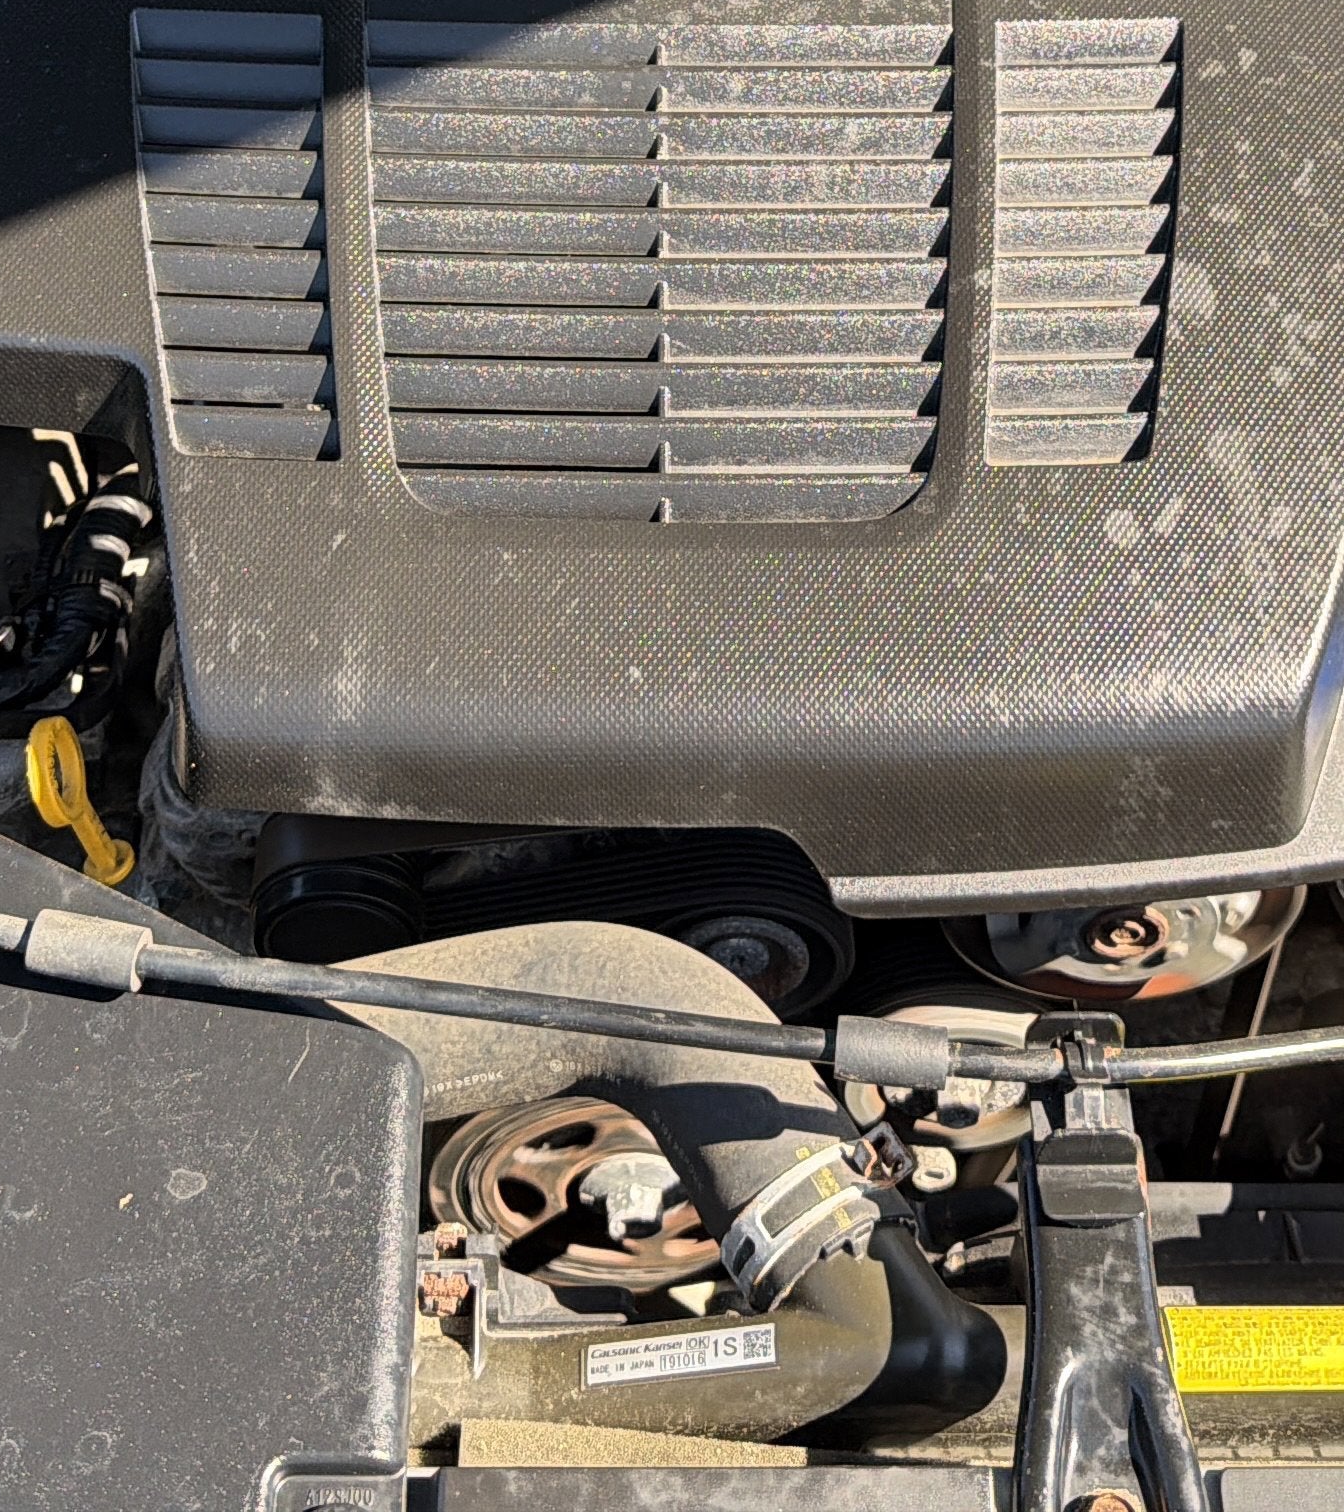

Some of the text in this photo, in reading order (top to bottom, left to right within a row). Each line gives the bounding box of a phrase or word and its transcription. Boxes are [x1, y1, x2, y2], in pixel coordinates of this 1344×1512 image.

[590, 1337, 738, 1360] Calsonic Kansei OK 1S
[589, 1351, 706, 1374] MADE IN JAPAN 191016
